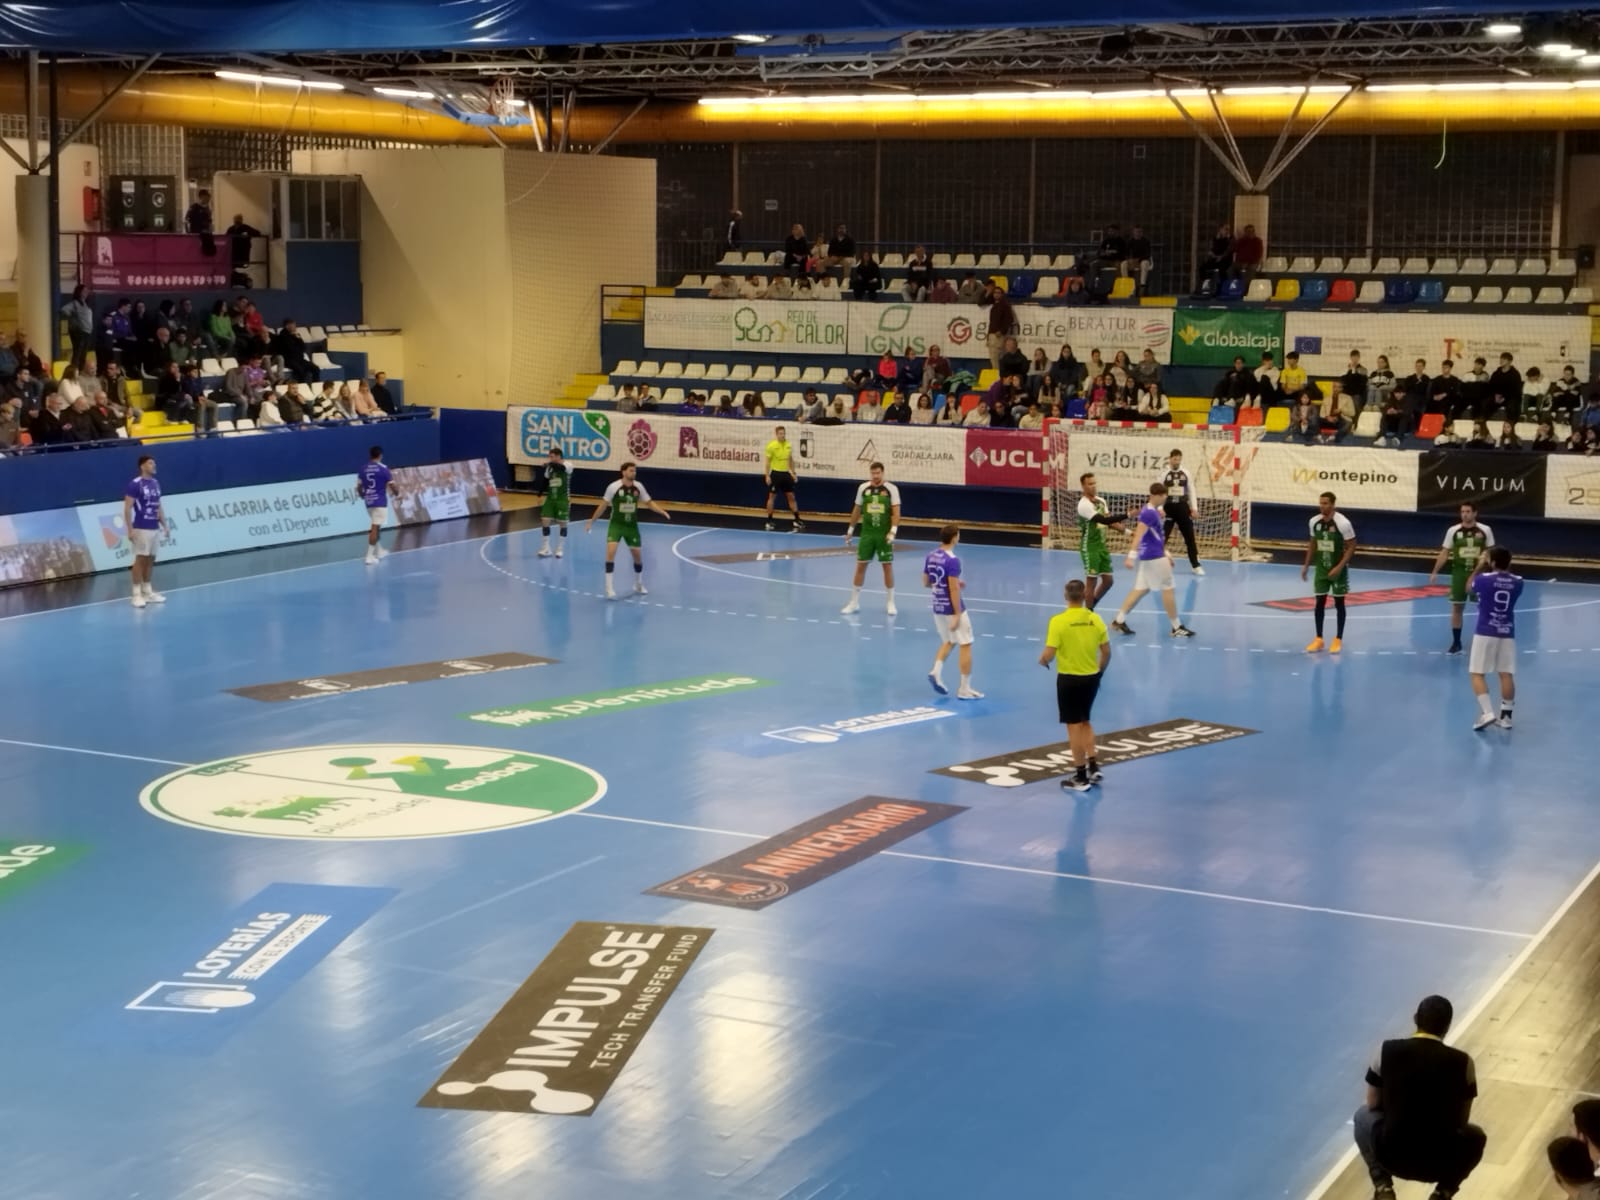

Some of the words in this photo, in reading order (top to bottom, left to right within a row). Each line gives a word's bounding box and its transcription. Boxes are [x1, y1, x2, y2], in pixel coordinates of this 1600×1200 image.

[796, 324, 845, 345] CALOR
[1069, 316, 1136, 332] BERATUR
[865, 335, 925, 356] IGNIS
[1204, 329, 1280, 349] Globalcaja
[526, 413, 574, 434] SANI
[526, 435, 608, 458] CENTRO
[892, 450, 954, 462] GUADALAJARA
[989, 449, 1066, 470] UCLM
[366, 472, 377, 489] 5
[1293, 466, 1398, 485] montepino
[1436, 474, 1526, 493] VIATUM
[186, 506, 204, 523] LA
[208, 499, 271, 521] ALCARRIA
[274, 499, 290, 511] de
[249, 524, 270, 537] con
[272, 519, 284, 533] el
[285, 514, 330, 534] Deporte
[928, 564, 948, 587] 52
[1494, 590, 1511, 612] 9
[551, 675, 758, 718] plenitude
[1009, 723, 1225, 772] IMULSE
[743, 803, 928, 879] ANIVERSARIO
[182, 911, 291, 979] LOTERÍAS
[505, 930, 665, 1068] IMPULSE
[590, 1031, 632, 1070] TECH
[620, 964, 679, 1029] TRANSFER
[666, 933, 698, 962] FUND
